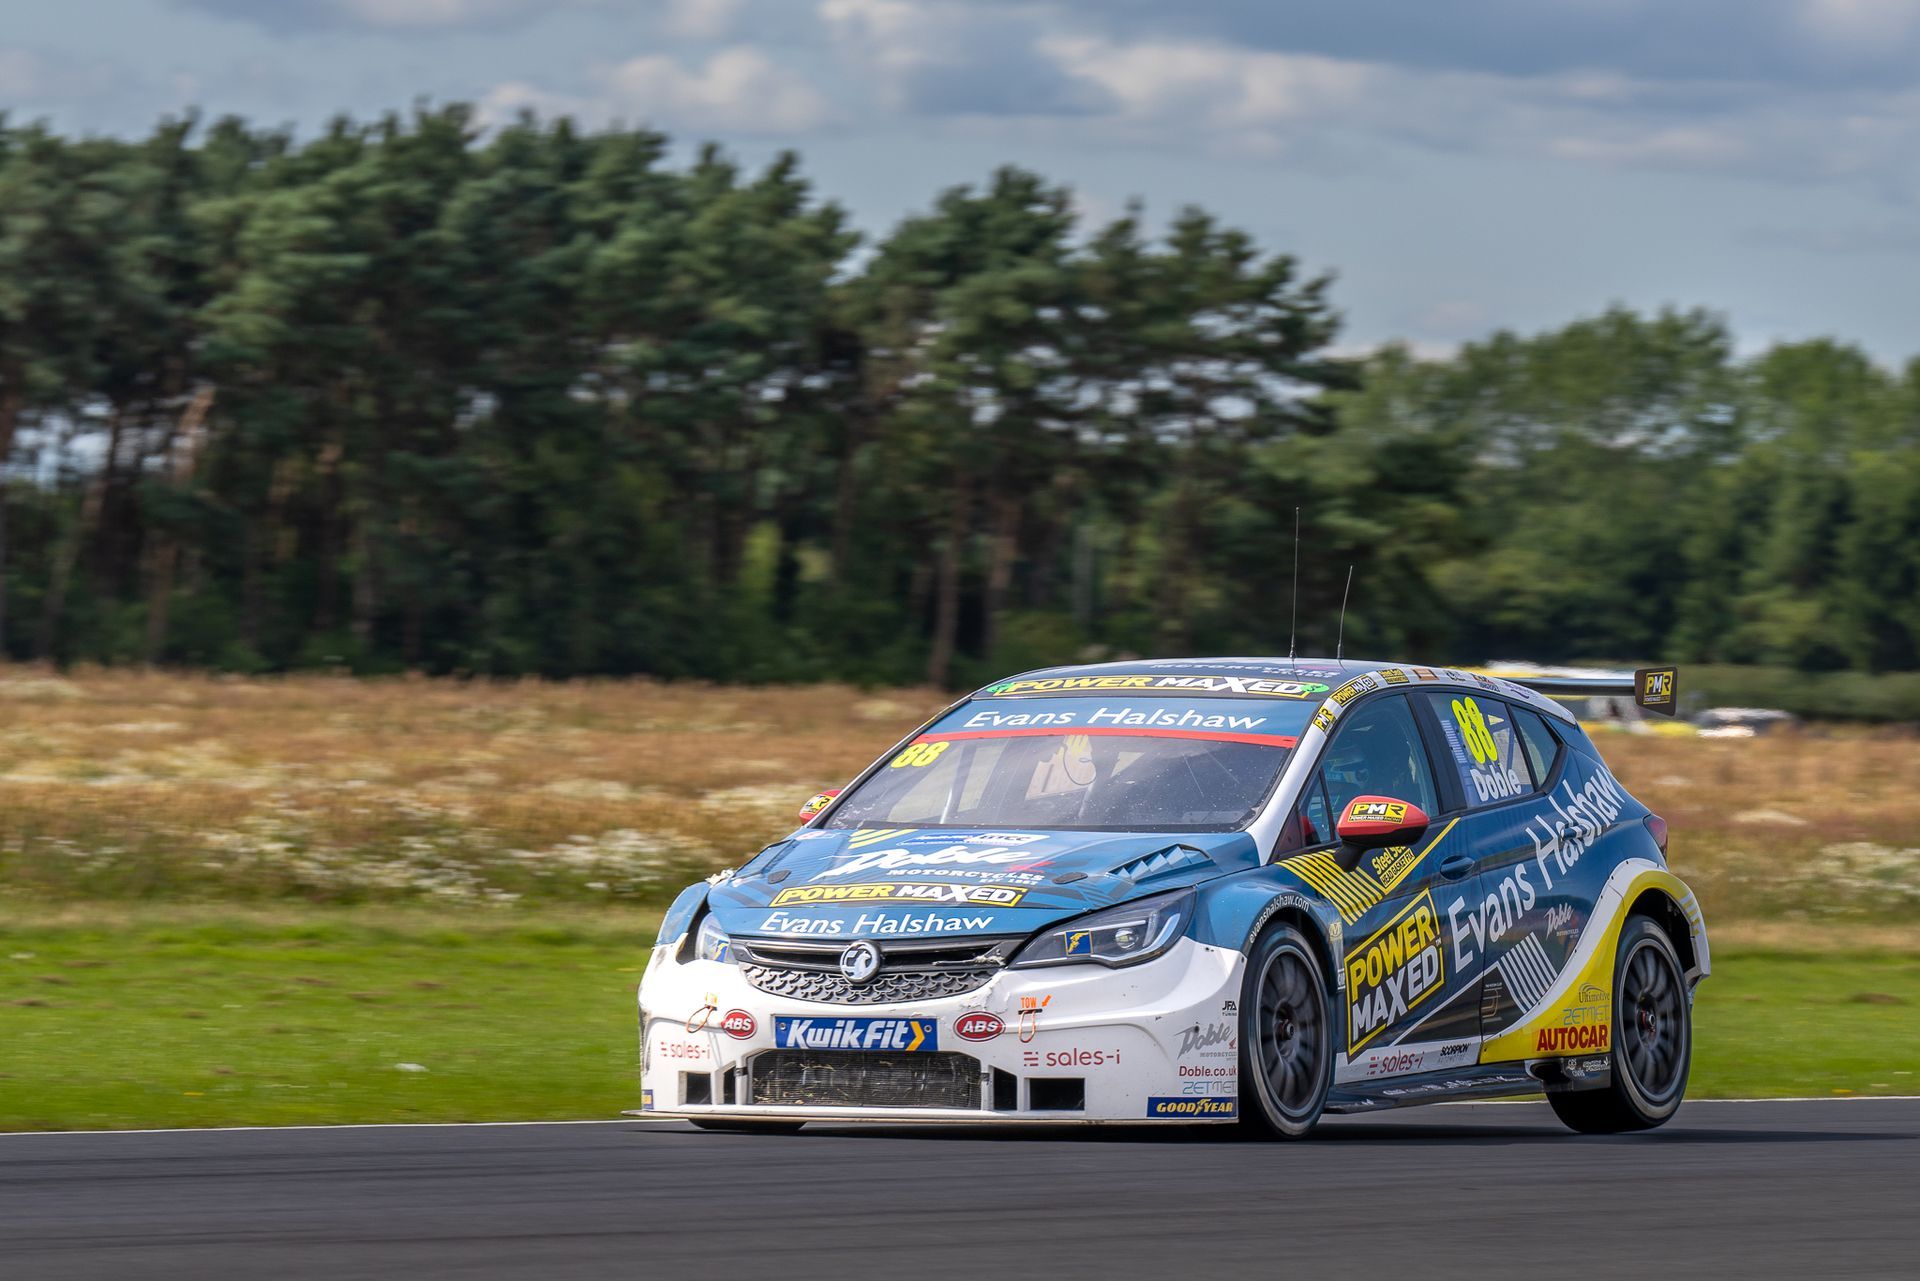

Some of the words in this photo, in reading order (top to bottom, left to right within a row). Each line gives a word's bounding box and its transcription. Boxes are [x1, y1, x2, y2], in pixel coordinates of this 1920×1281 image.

[1008, 677, 1153, 692] POWER
[1155, 676, 1303, 693] MAXED
[1335, 685, 1356, 702] POWER
[1352, 676, 1375, 692] MAXED
[1646, 674, 1671, 693] PMR
[963, 711, 1076, 728] Evans
[1087, 707, 1267, 729] Halshaw
[1314, 708, 1332, 731] PMR
[1452, 696, 1498, 764] 88
[891, 741, 949, 768] 88
[1470, 763, 1522, 801] Doble
[1352, 803, 1404, 815] PMR
[1371, 847, 1395, 875] Steel
[1447, 863, 1536, 974] Evans
[1525, 765, 1625, 890] Halshaw
[783, 884, 896, 902] POWER
[896, 885, 1019, 902] MAXED
[759, 912, 844, 934] Evans
[852, 913, 995, 934] Halshaw
[1248, 895, 1310, 944] evanshalshaw.com
[1350, 905, 1436, 1002] POWER
[1020, 997, 1037, 1009] TOW
[1352, 945, 1440, 1042] MAXED
[1222, 1000, 1237, 1010] JFA
[723, 1018, 751, 1031] ABS
[961, 1020, 999, 1034] ABS
[1536, 1024, 1608, 1051] AUTOCAR
[670, 1041, 711, 1060] sales-i
[1046, 1047, 1121, 1068] sales-i
[1439, 1042, 1471, 1057] SCORPION
[1178, 1065, 1237, 1077] Doble.co.uk
[1379, 1049, 1425, 1075] sales-i
